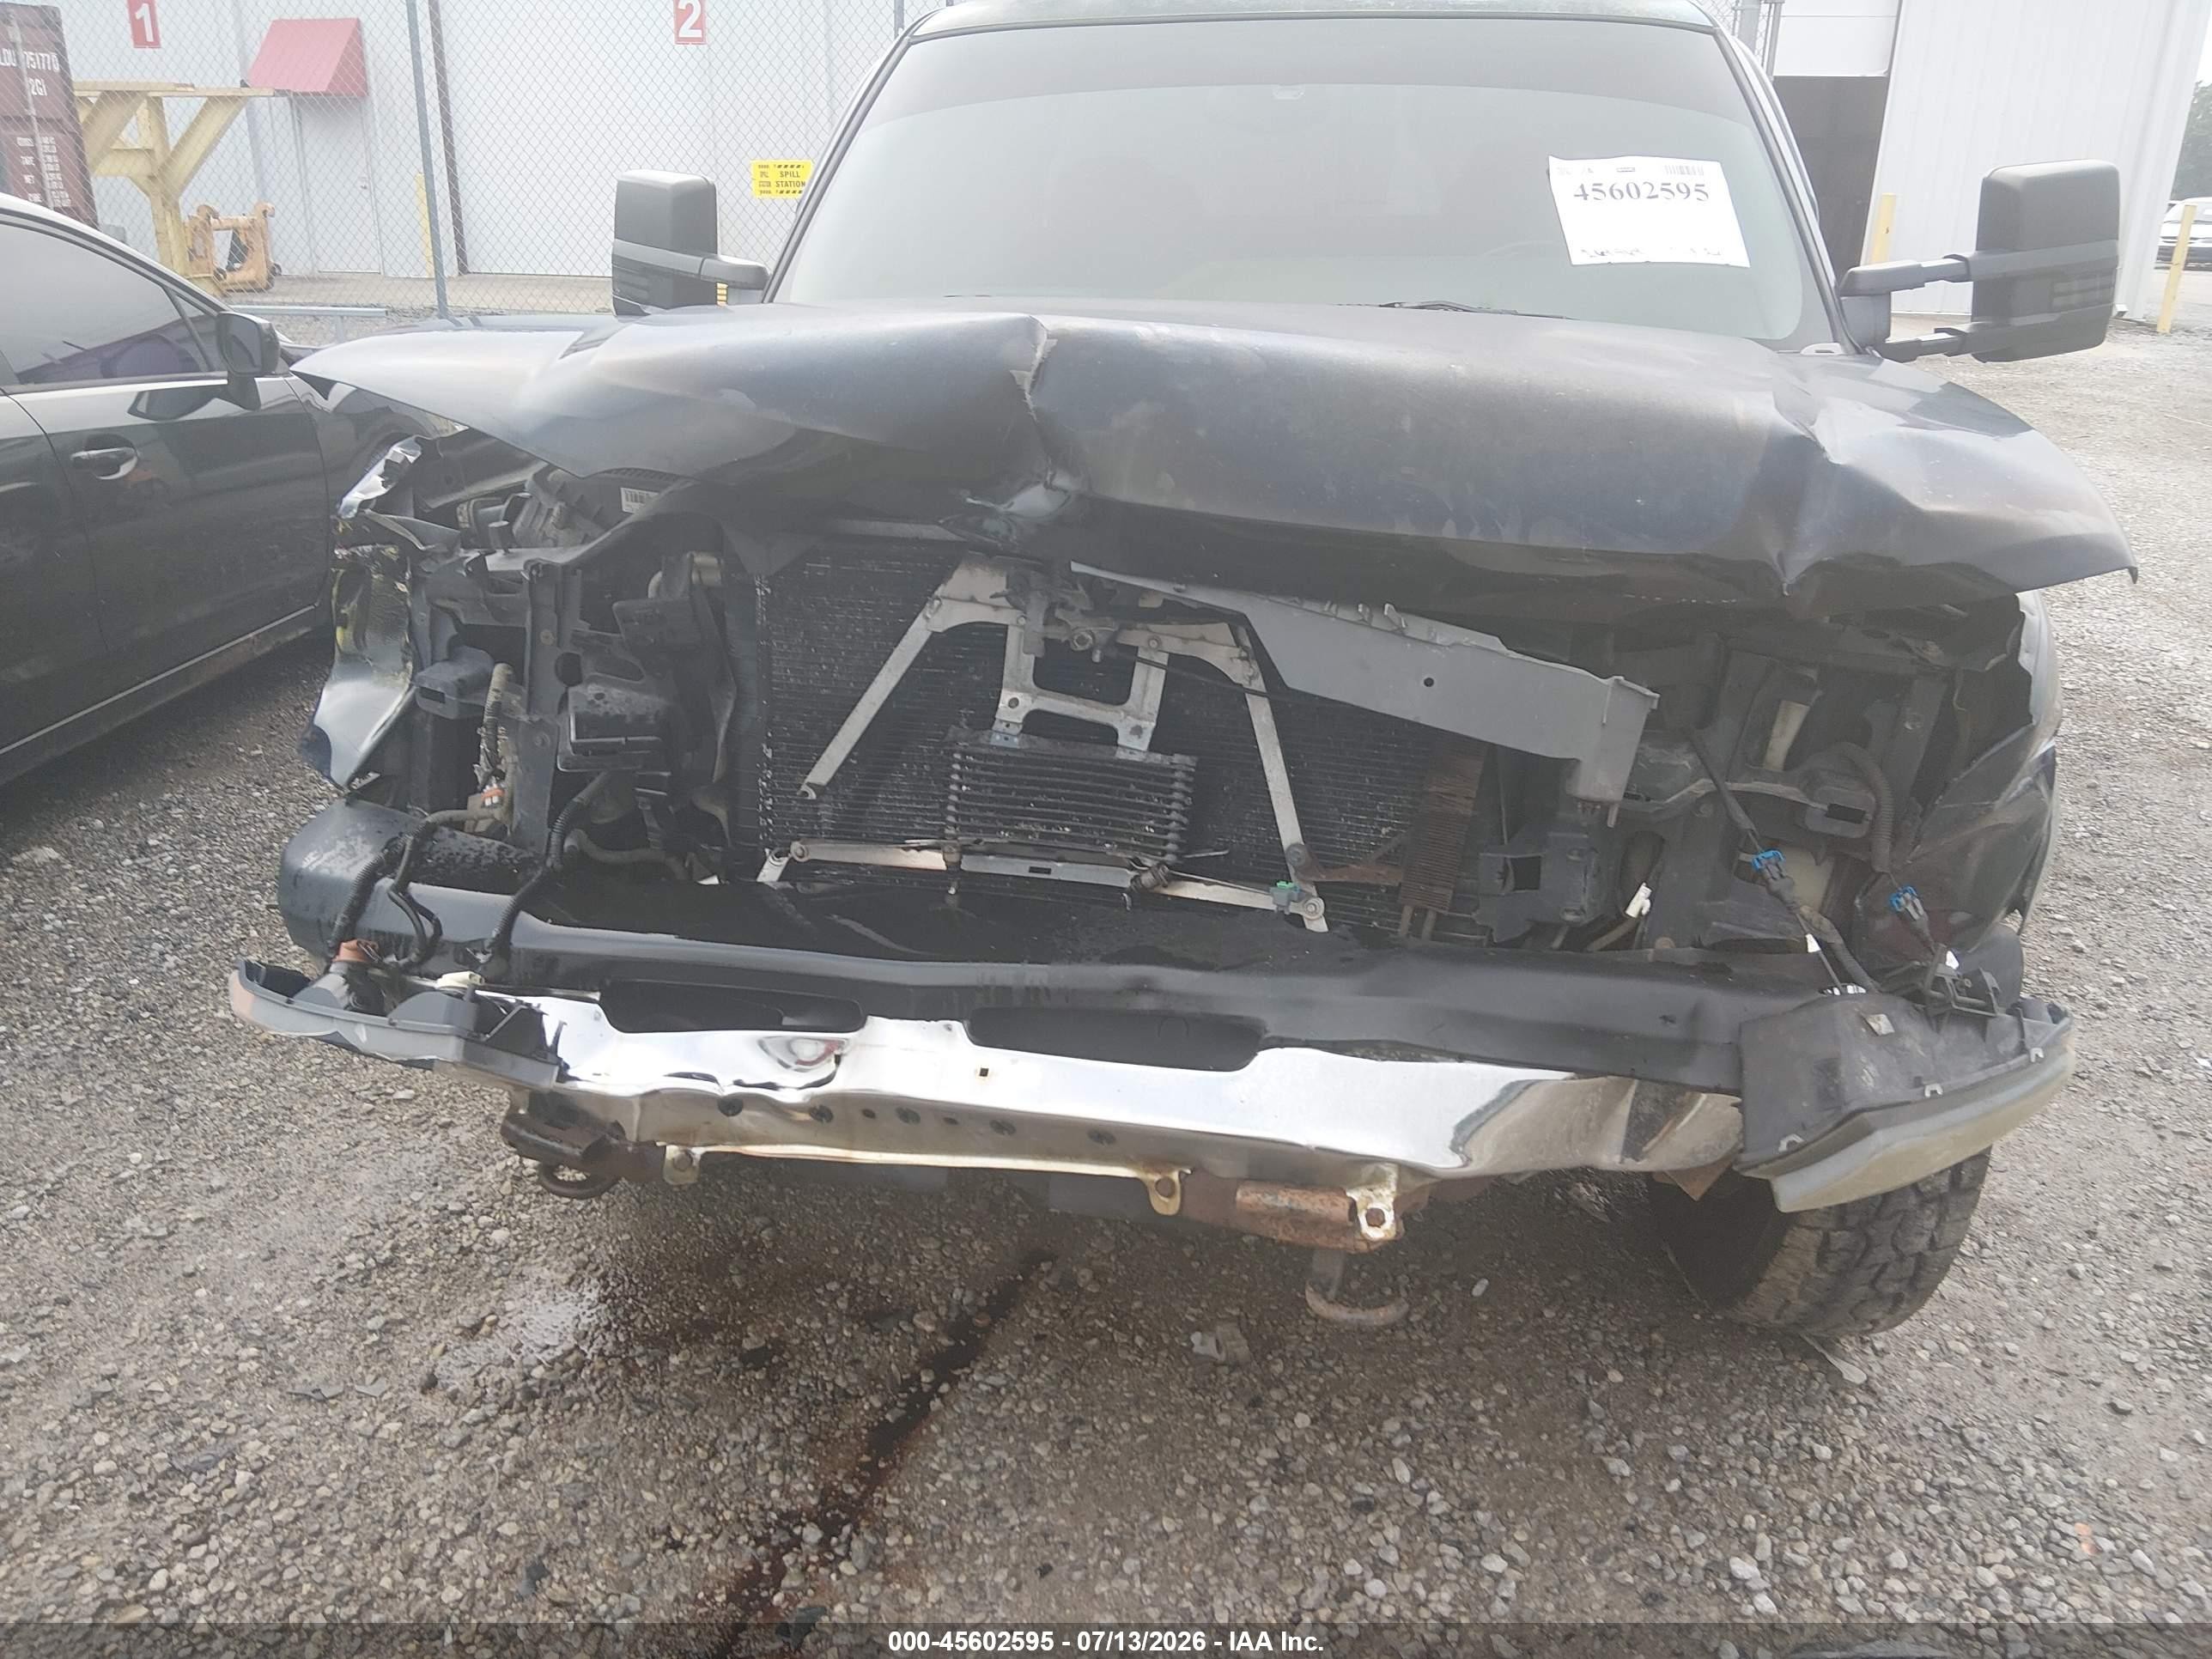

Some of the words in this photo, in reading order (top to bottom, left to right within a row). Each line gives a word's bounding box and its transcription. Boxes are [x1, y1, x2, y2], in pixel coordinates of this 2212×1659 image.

[135, 3, 154, 42] 1
[677, 0, 702, 38] 2
[1573, 181, 1709, 201] 45602595
